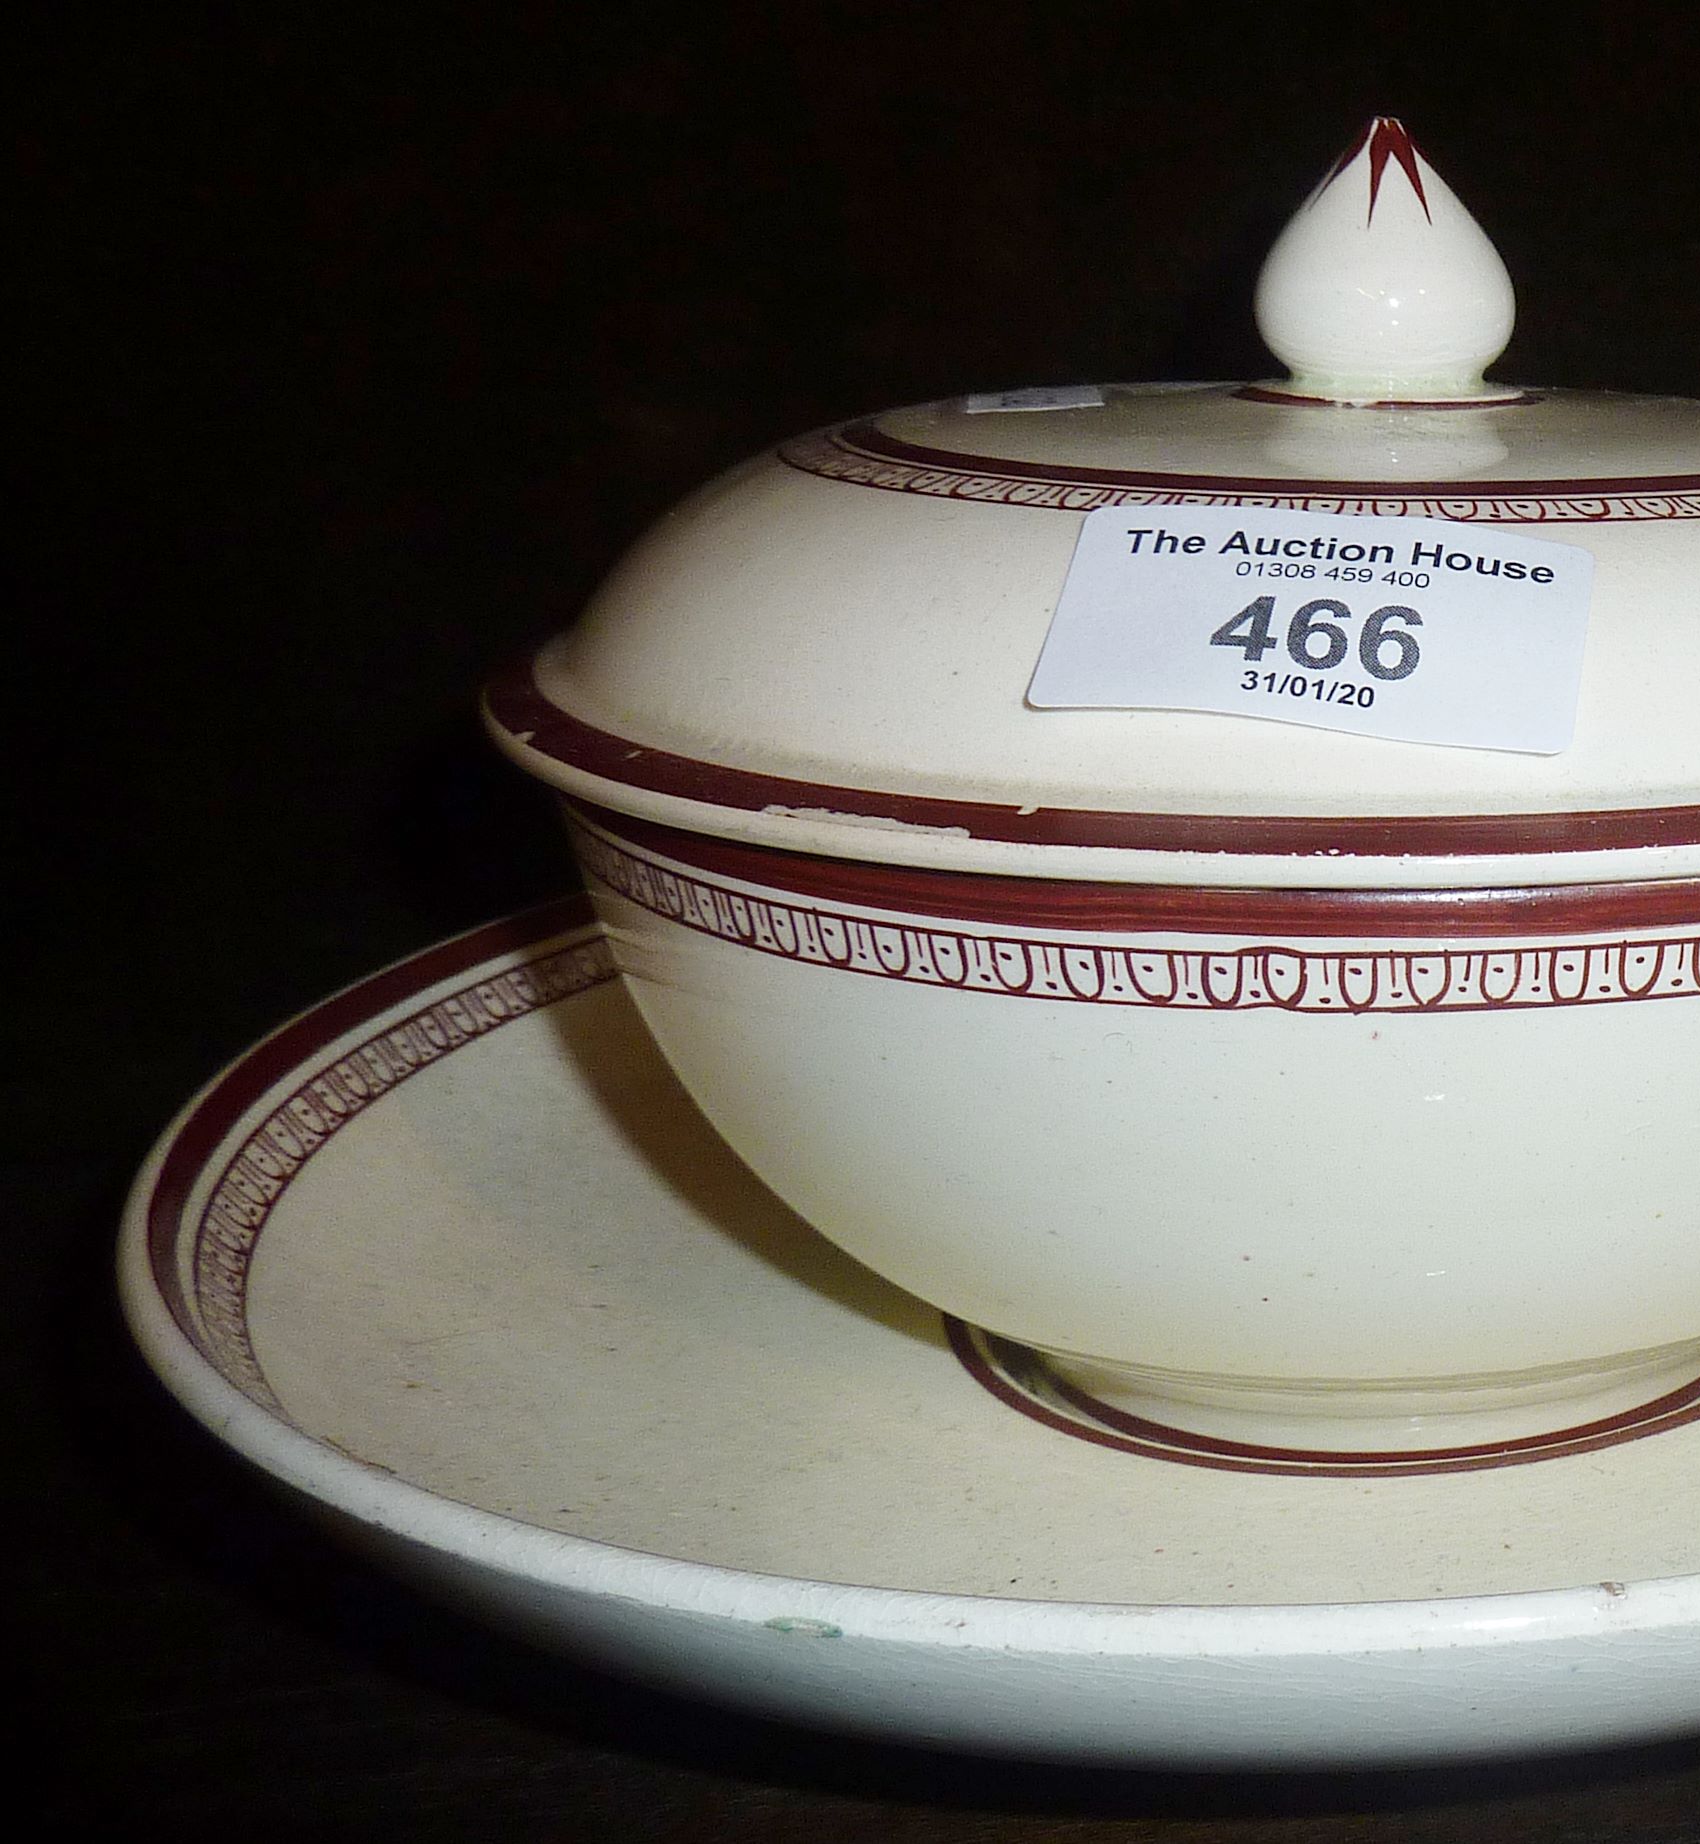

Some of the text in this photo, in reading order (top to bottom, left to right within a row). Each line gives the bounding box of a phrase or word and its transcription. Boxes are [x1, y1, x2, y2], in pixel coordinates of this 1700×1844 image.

[1126, 529, 1554, 584] The Auction House
[1235, 561, 1430, 588] 01308 459 400
[1210, 596, 1424, 680] 466
[1240, 670, 1375, 708] 31/01/20
